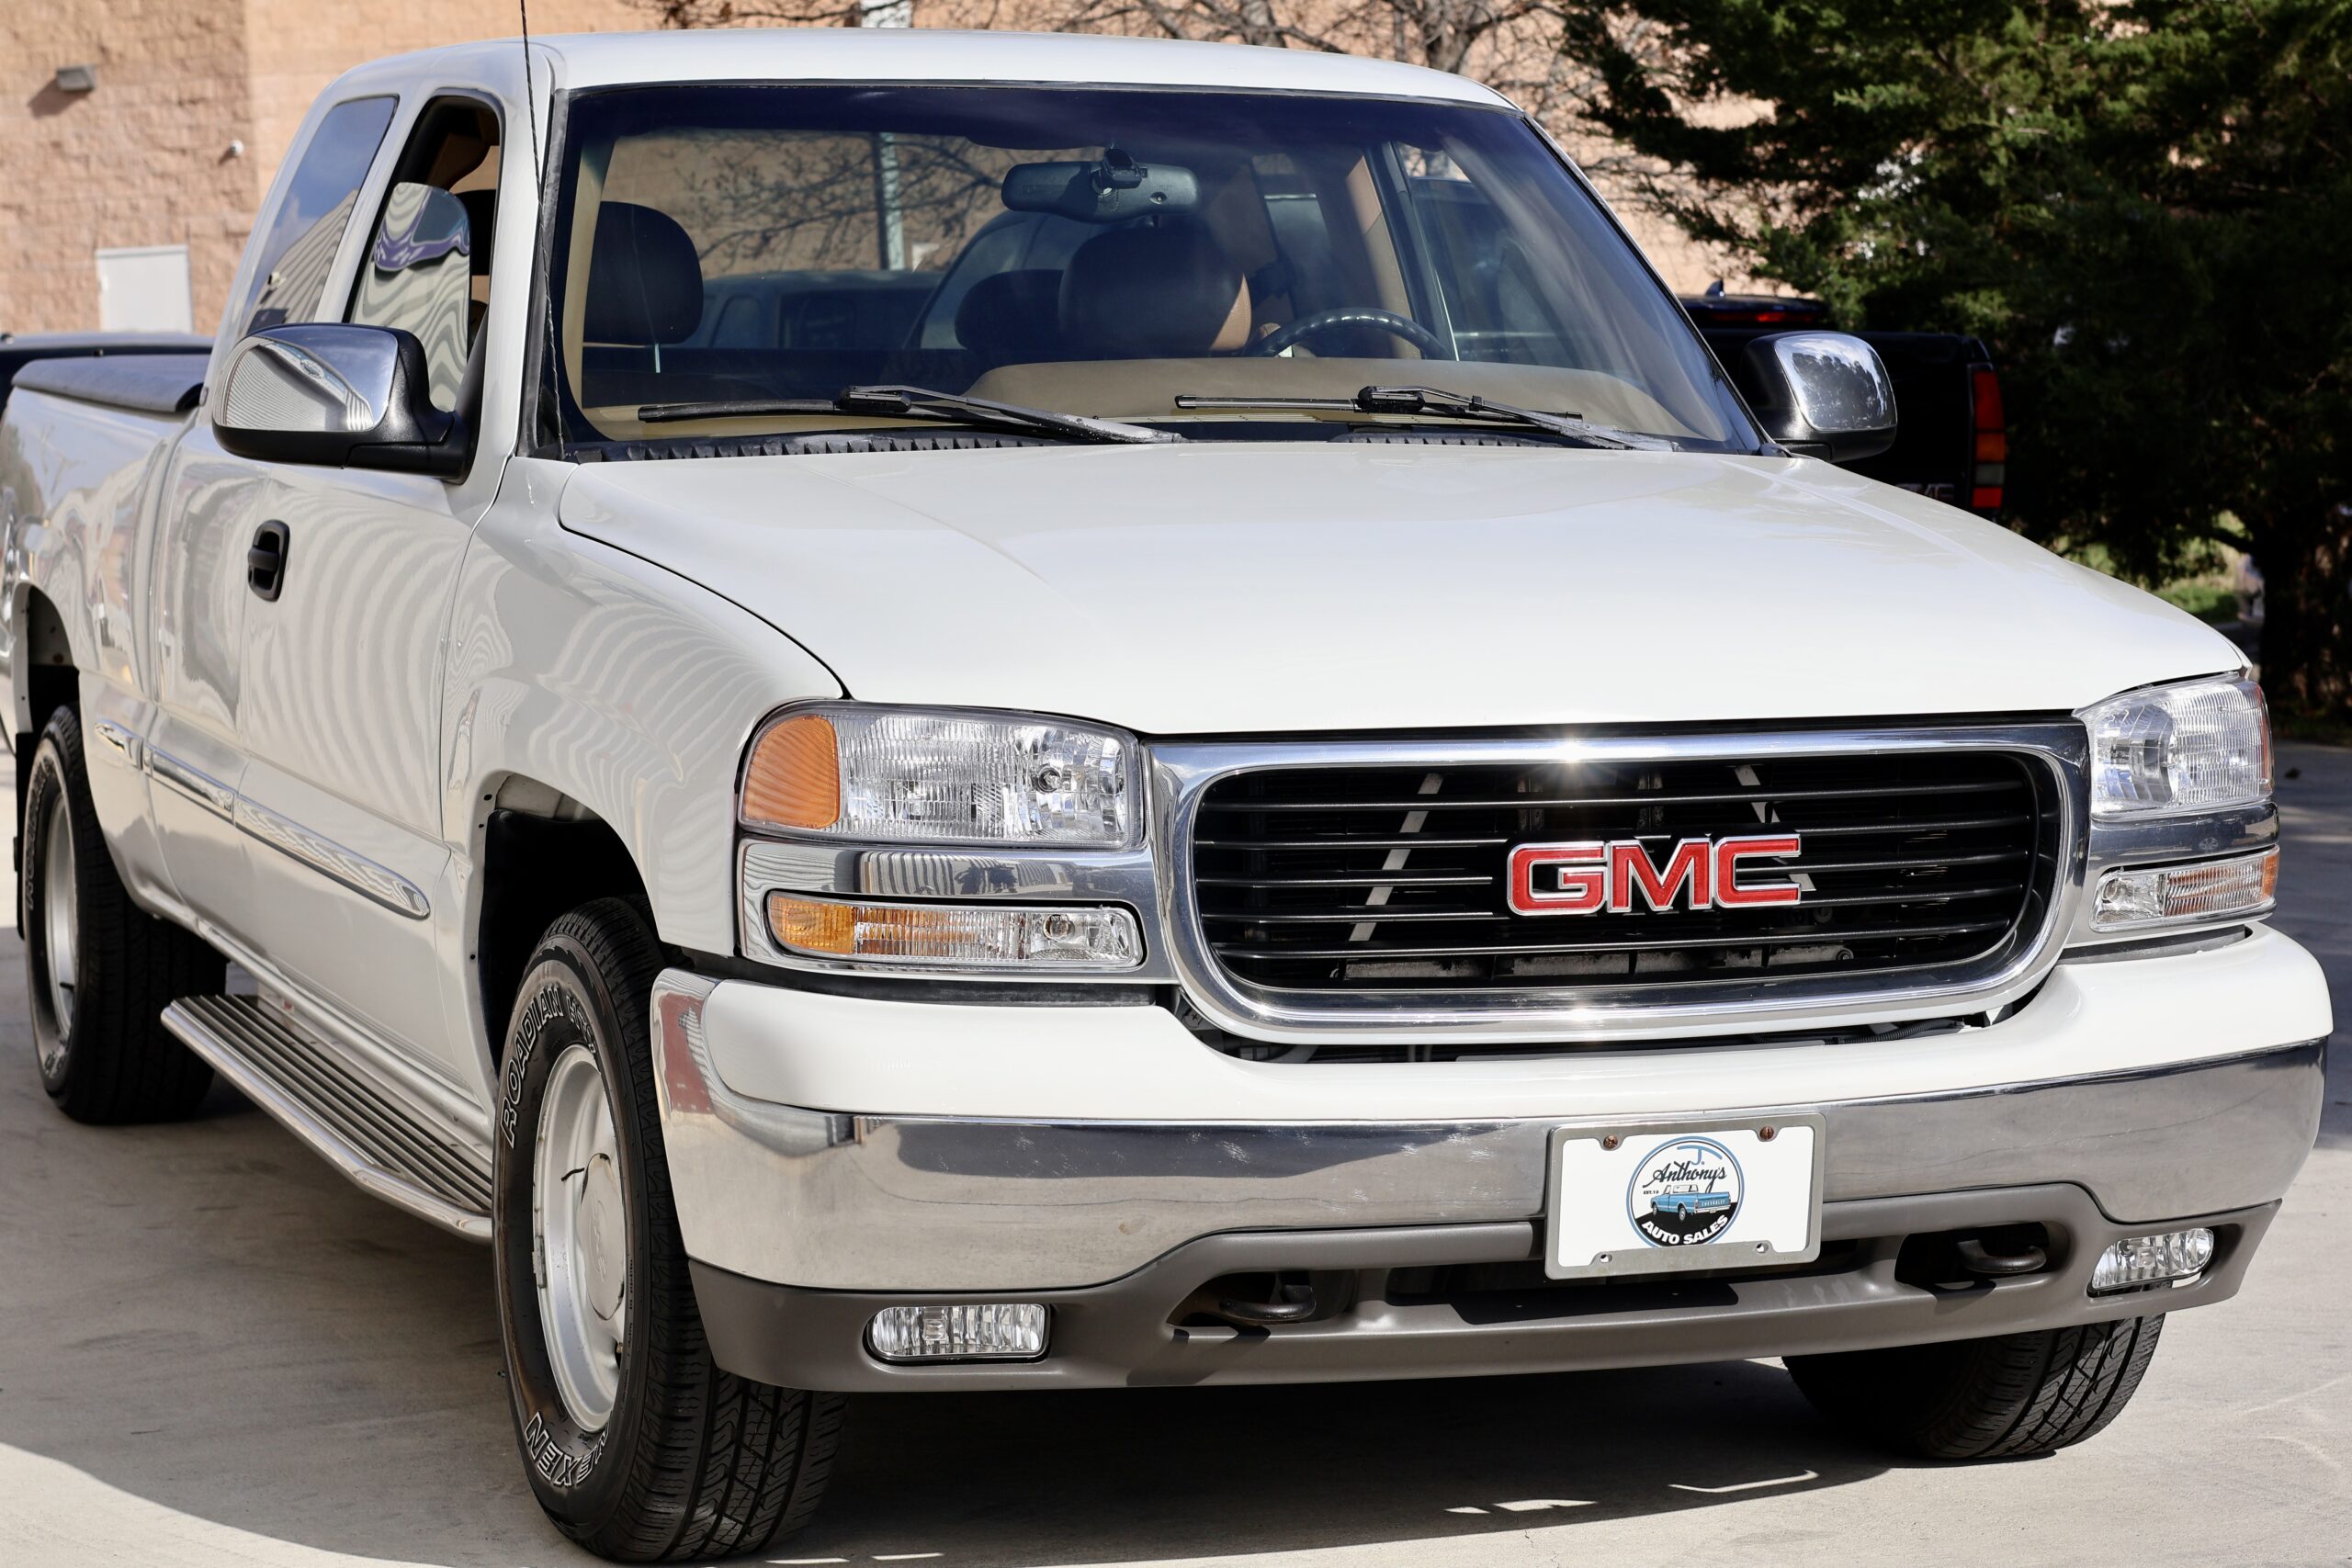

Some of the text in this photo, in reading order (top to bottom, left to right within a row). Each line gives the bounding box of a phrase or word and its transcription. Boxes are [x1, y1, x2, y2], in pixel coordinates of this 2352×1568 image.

[1507, 833, 1801, 916] GMC
[500, 986, 564, 1149] ROADIAN
[1643, 1160, 1727, 1193] Anthony's
[1641, 1214, 1728, 1244] AUTO SALES
[525, 1411, 610, 1486] NEXEN
